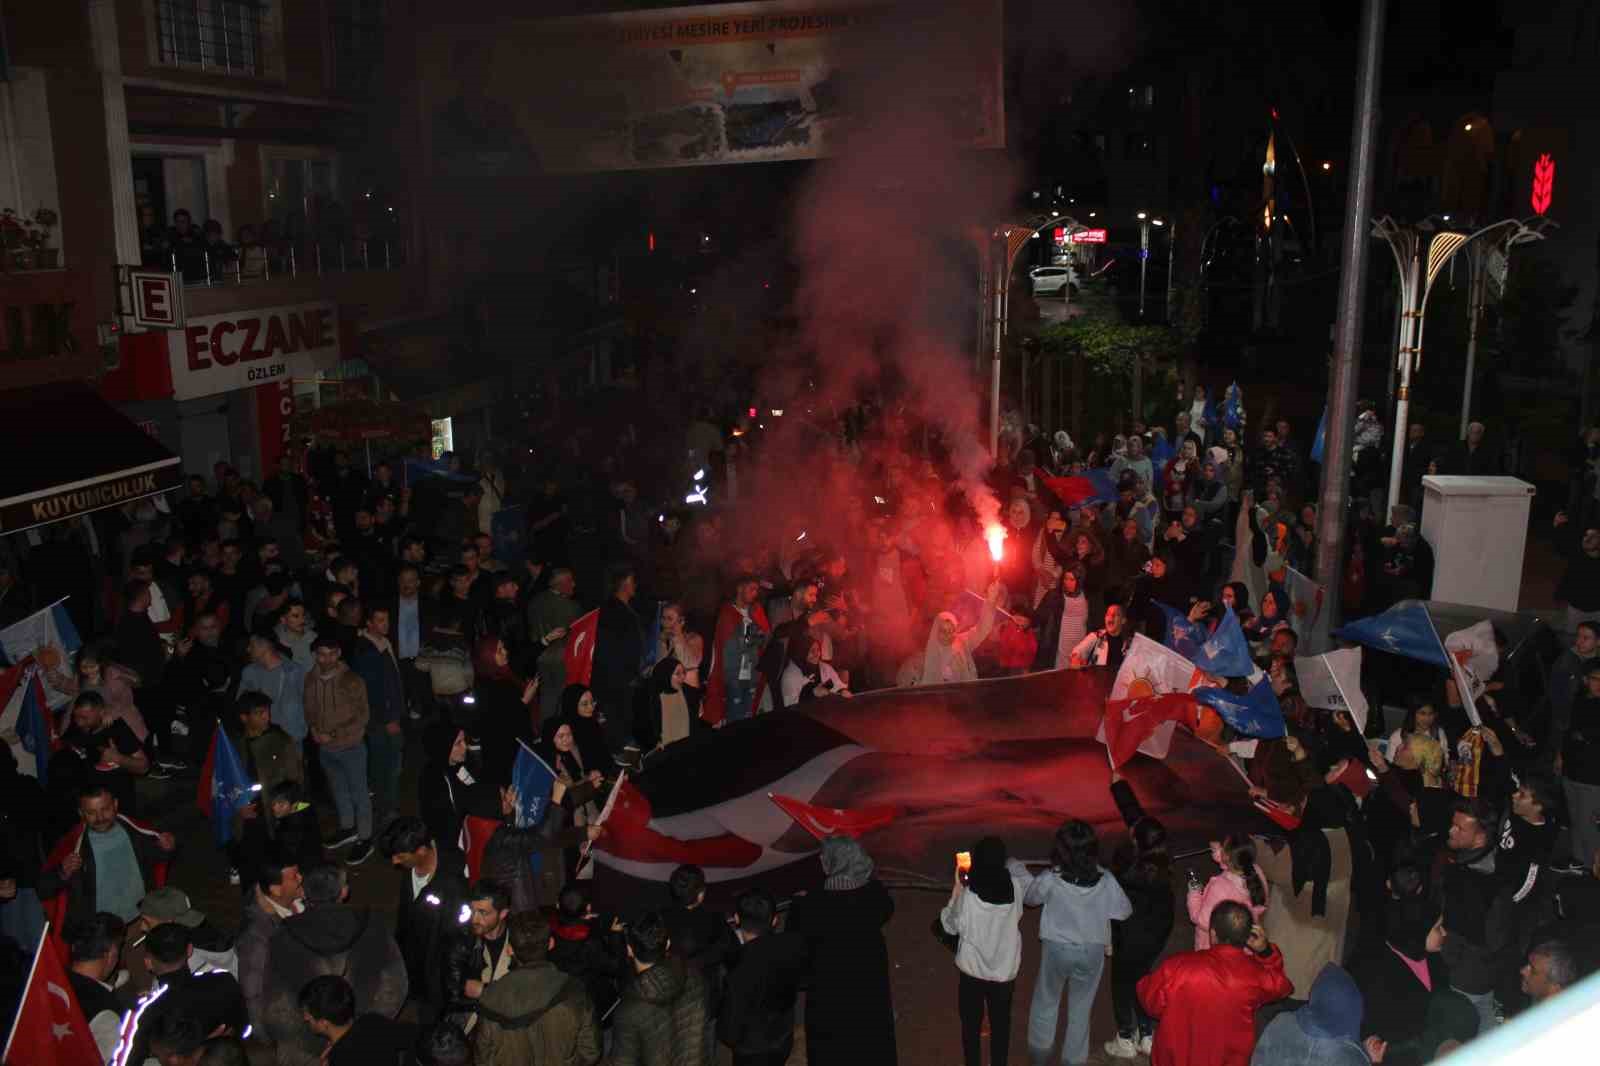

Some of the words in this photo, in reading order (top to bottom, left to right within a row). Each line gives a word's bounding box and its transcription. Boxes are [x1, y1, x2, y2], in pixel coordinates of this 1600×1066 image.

[678, 17, 729, 38] MESİRE
[142, 280, 168, 320] E
[185, 308, 336, 372] ECZANE
[247, 363, 286, 381] ÖZLEM
[31, 473, 156, 521] KUYUMCULUK
